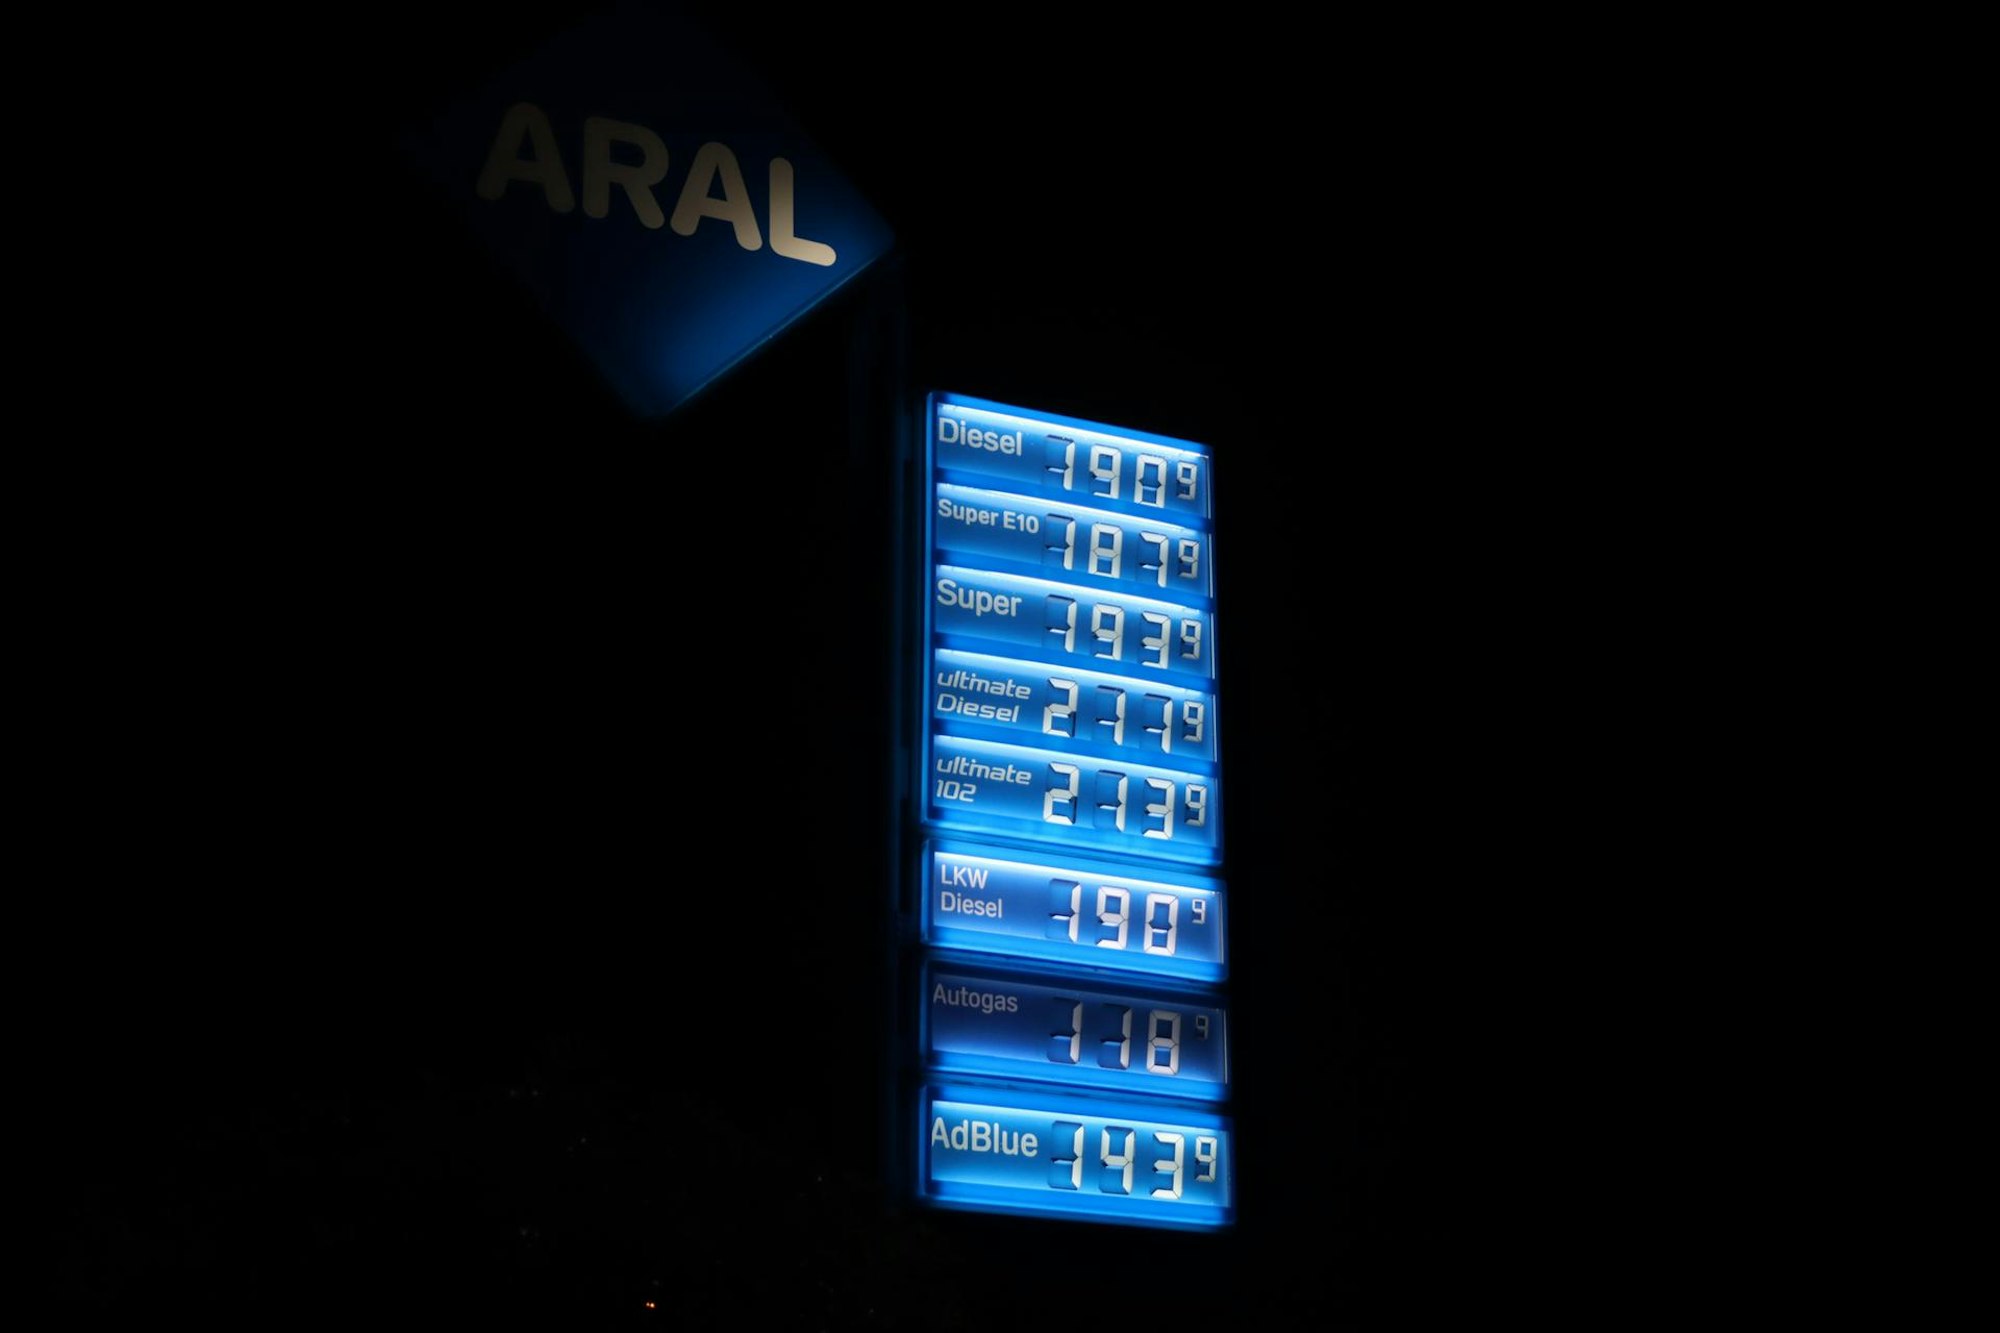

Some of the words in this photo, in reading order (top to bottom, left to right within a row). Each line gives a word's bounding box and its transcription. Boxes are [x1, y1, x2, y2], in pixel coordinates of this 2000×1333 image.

[476, 102, 837, 267] ARAL
[937, 417, 1023, 456] Diesel
[937, 498, 999, 526] Super
[1003, 510, 1040, 534] E10
[937, 578, 1023, 617] Super
[937, 669, 1032, 700] ultimate
[936, 693, 1021, 723] Diesel
[936, 755, 1032, 786] ultimate
[936, 779, 977, 803] 102
[941, 864, 989, 889] LKW
[940, 892, 1003, 919] Diesel
[932, 983, 1019, 1014] Autogas
[931, 1116, 1039, 1158] AdBlue
